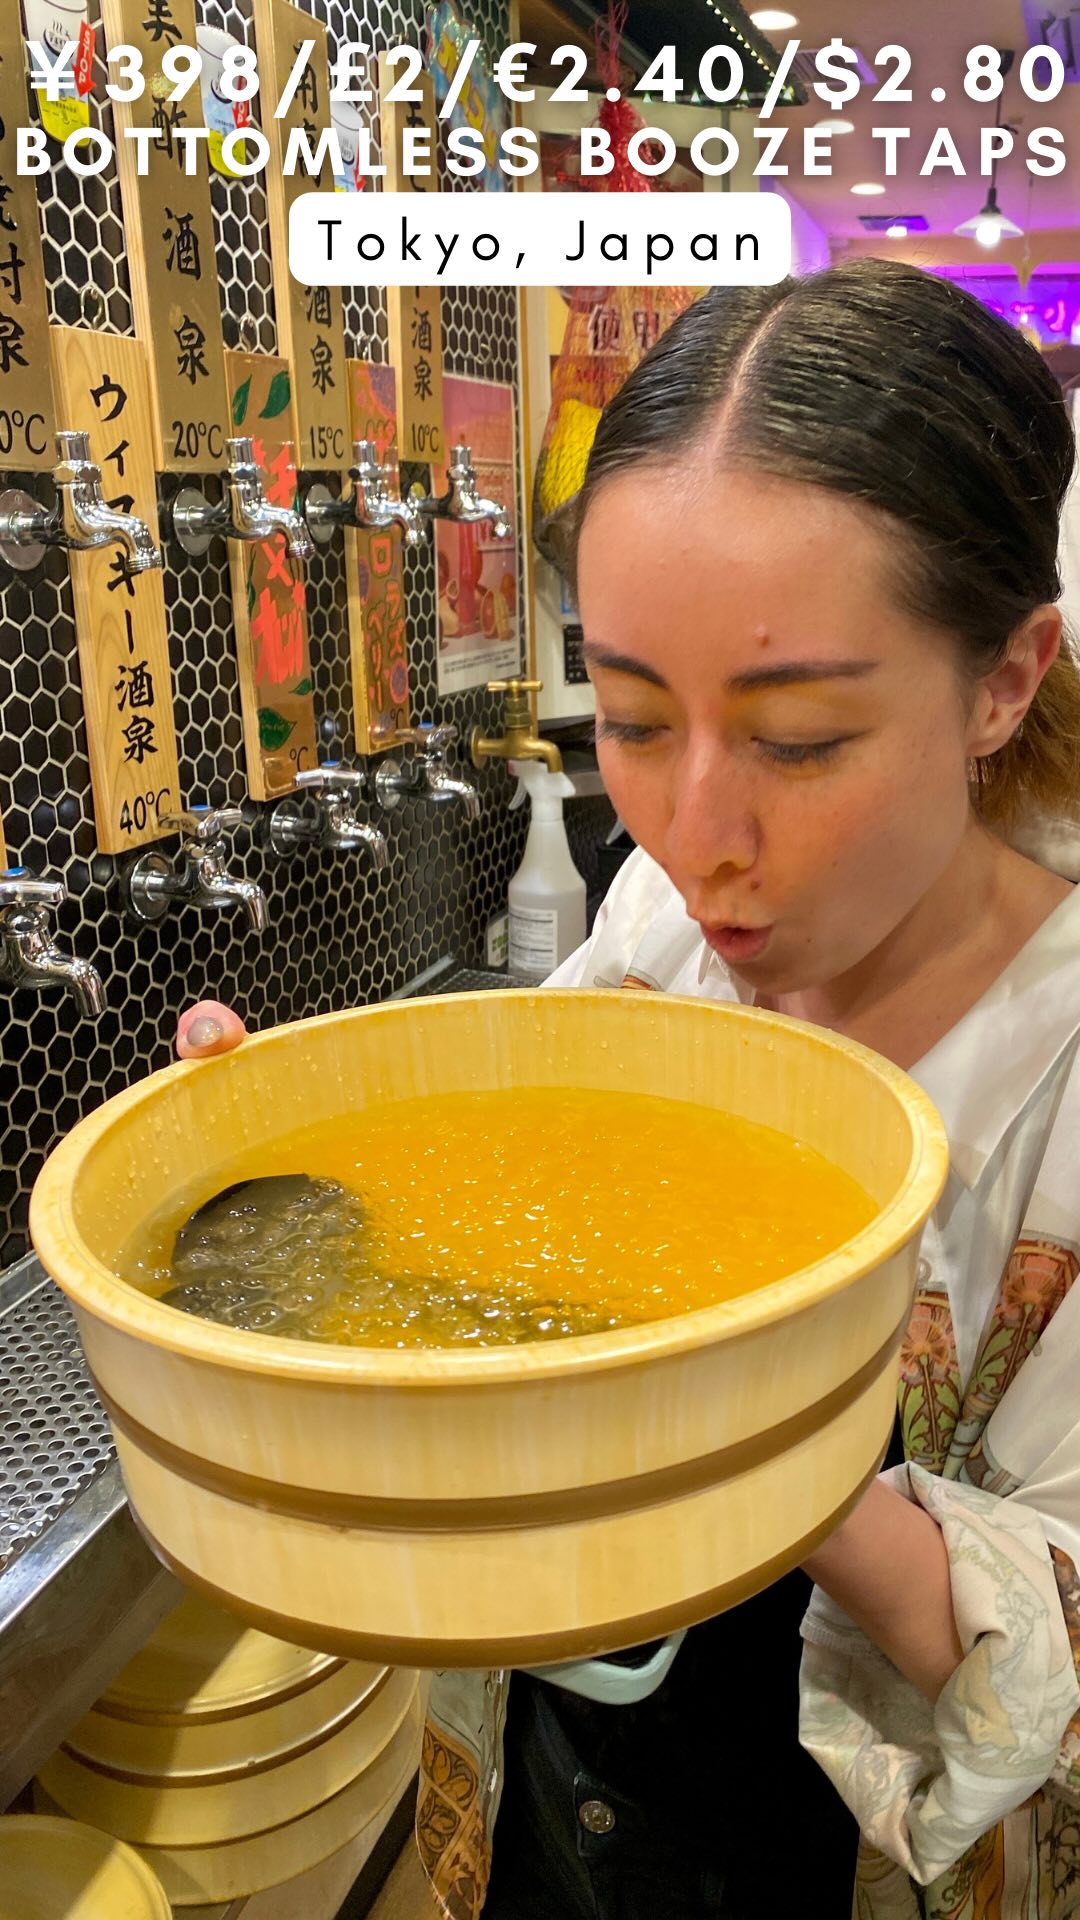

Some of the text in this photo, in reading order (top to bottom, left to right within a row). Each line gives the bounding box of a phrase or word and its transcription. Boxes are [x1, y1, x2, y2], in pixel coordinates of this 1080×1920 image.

[78, 30, 91, 84] STOP
[172, 420, 223, 459] 20°C
[309, 424, 344, 459] 15°C
[412, 423, 440, 454] 10°C
